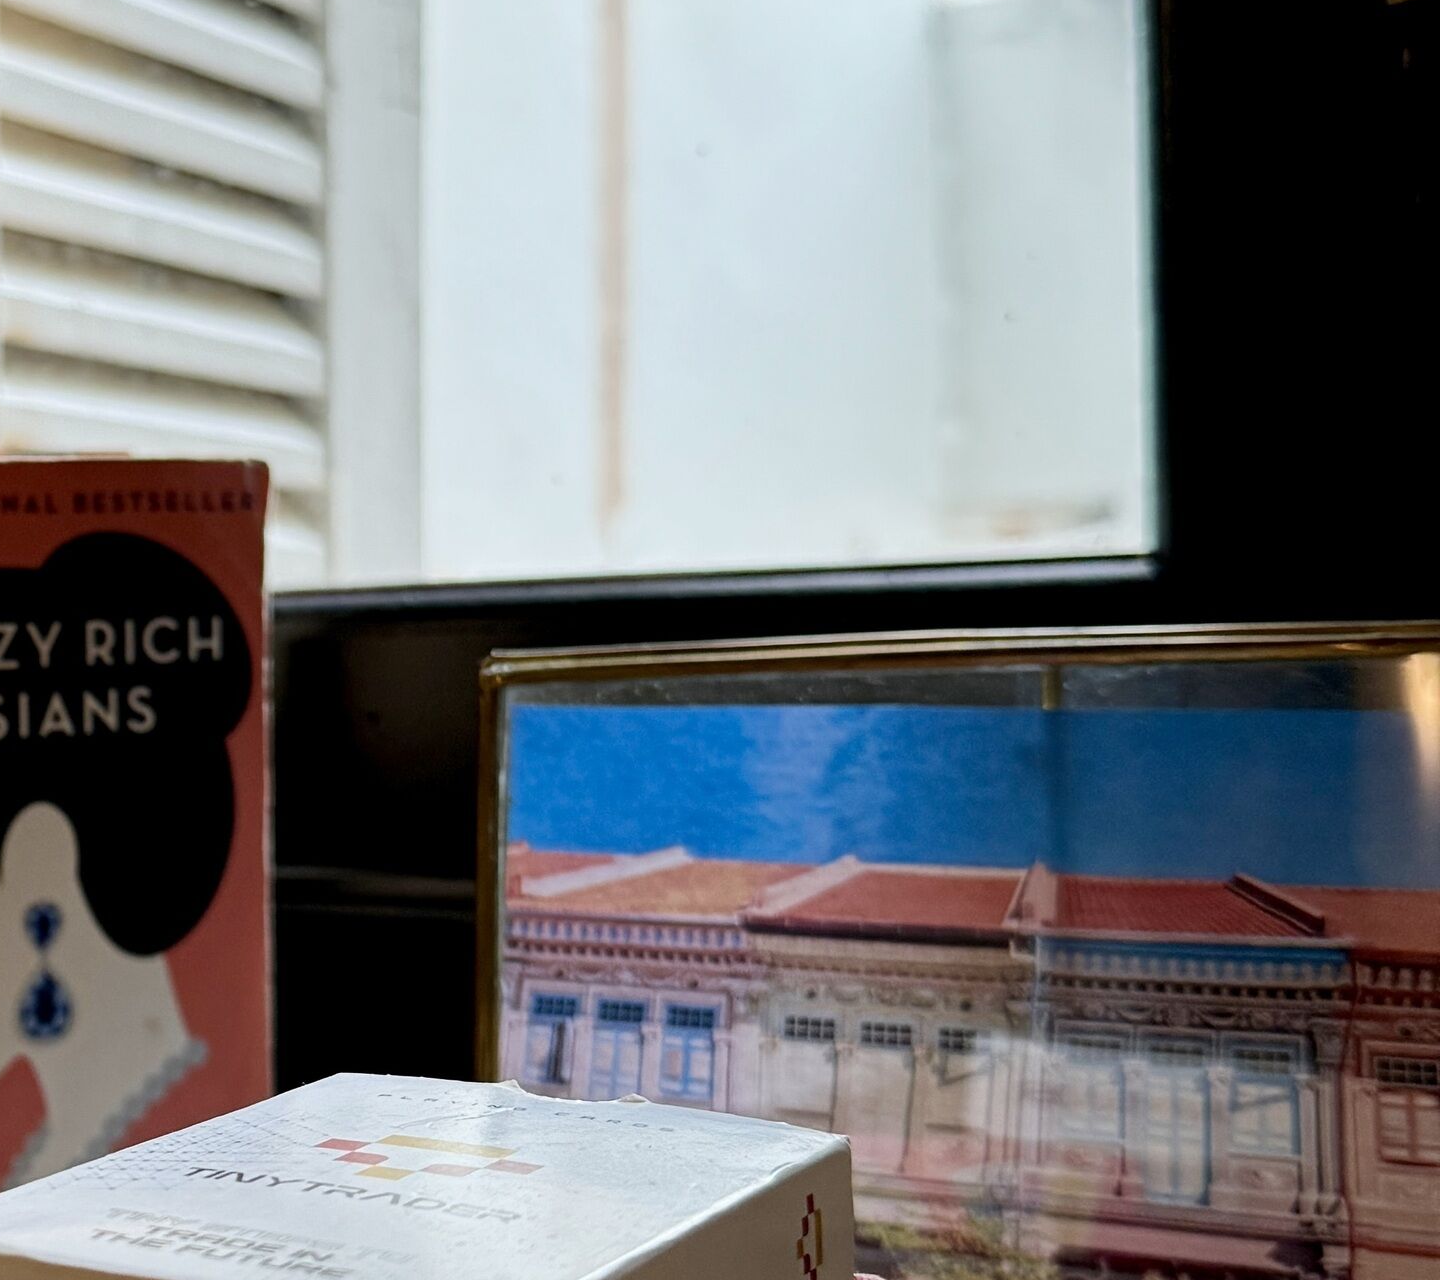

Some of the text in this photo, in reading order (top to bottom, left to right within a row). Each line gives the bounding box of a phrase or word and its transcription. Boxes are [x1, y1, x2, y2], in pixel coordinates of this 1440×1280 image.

[71, 488, 254, 516] BESTSELLER
[84, 615, 224, 667] RICH
[186, 1165, 523, 1224] TINYTRADER
[90, 1228, 356, 1279] THE FUTURE
[146, 1223, 335, 1263] TRADE IN
